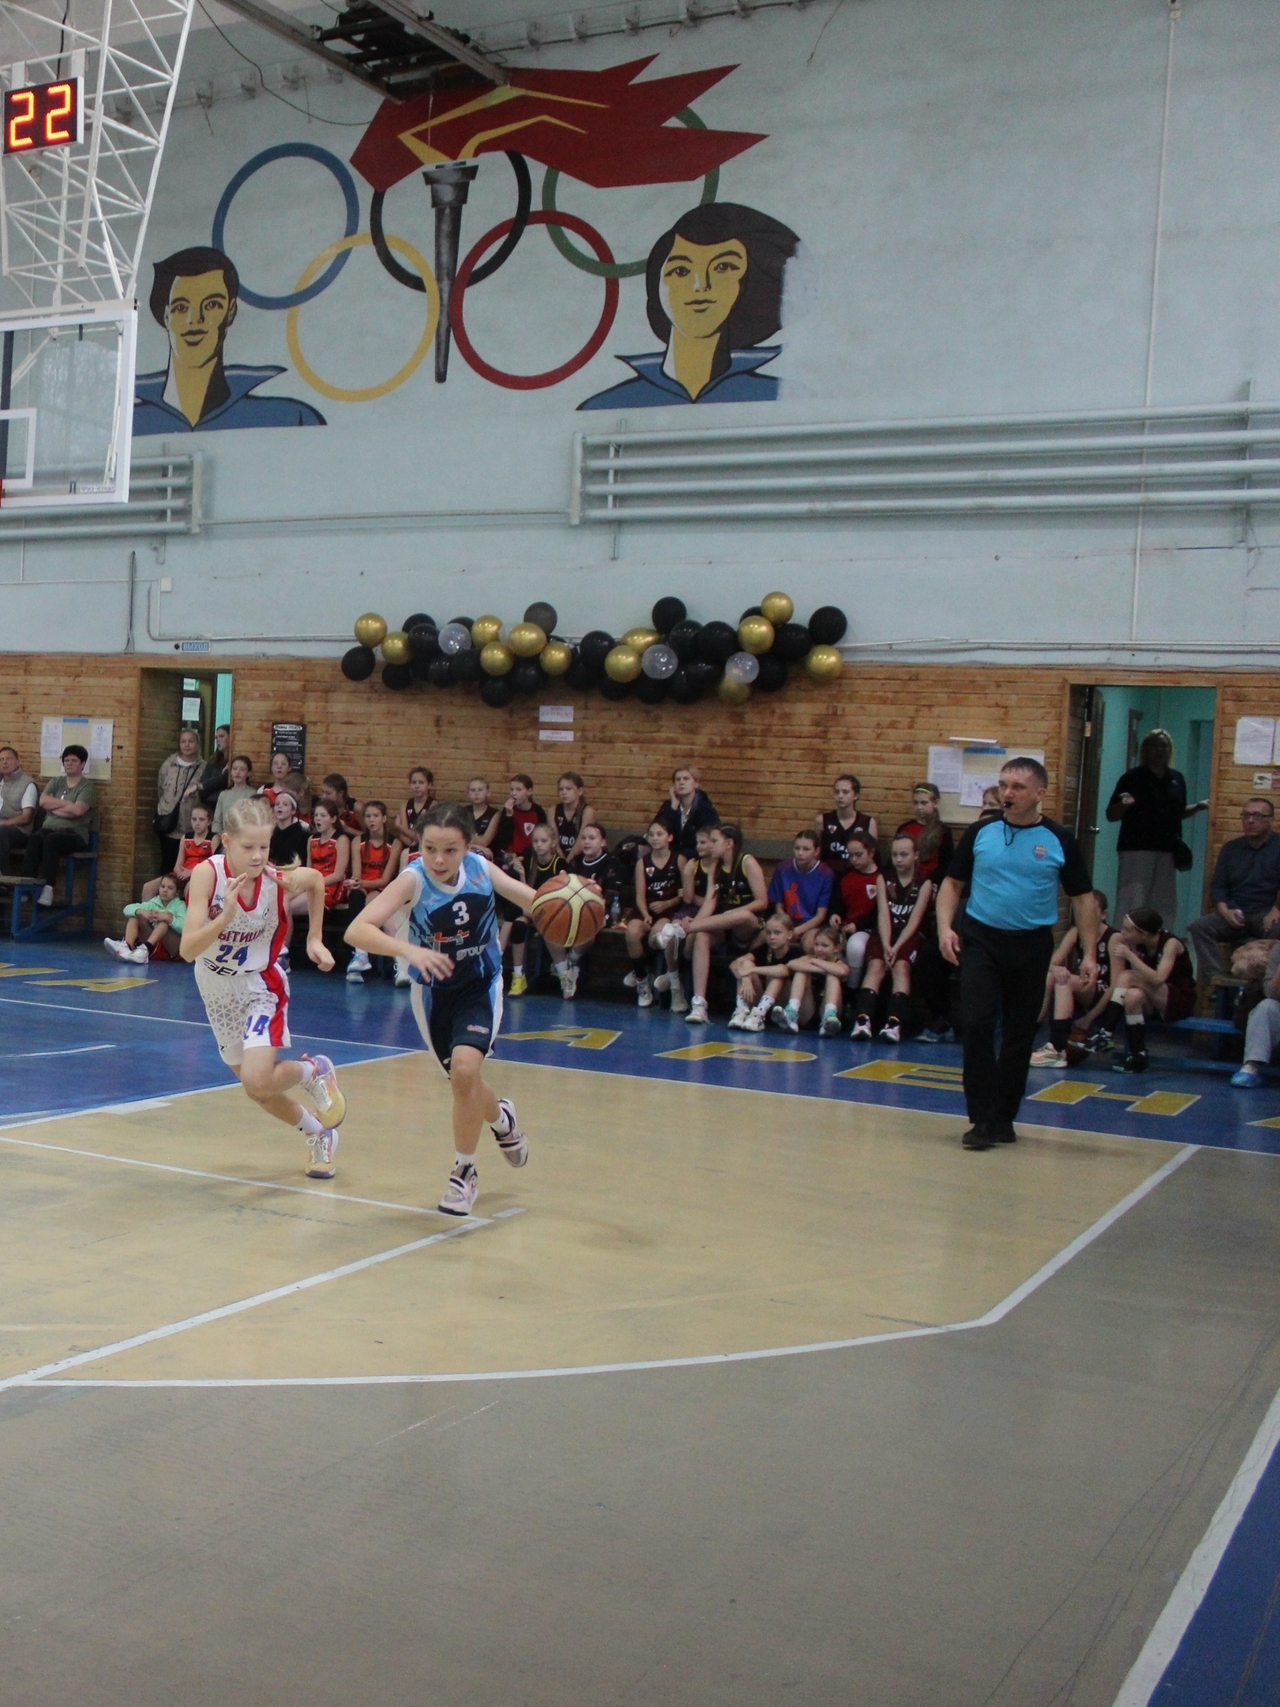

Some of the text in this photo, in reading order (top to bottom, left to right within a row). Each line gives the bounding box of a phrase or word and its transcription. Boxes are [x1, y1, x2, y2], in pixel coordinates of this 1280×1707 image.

[9, 84, 72, 148] 22
[451, 901, 470, 926] 3
[215, 944, 249, 967] 24
[498, 1025, 1280, 1129] АРЕН
